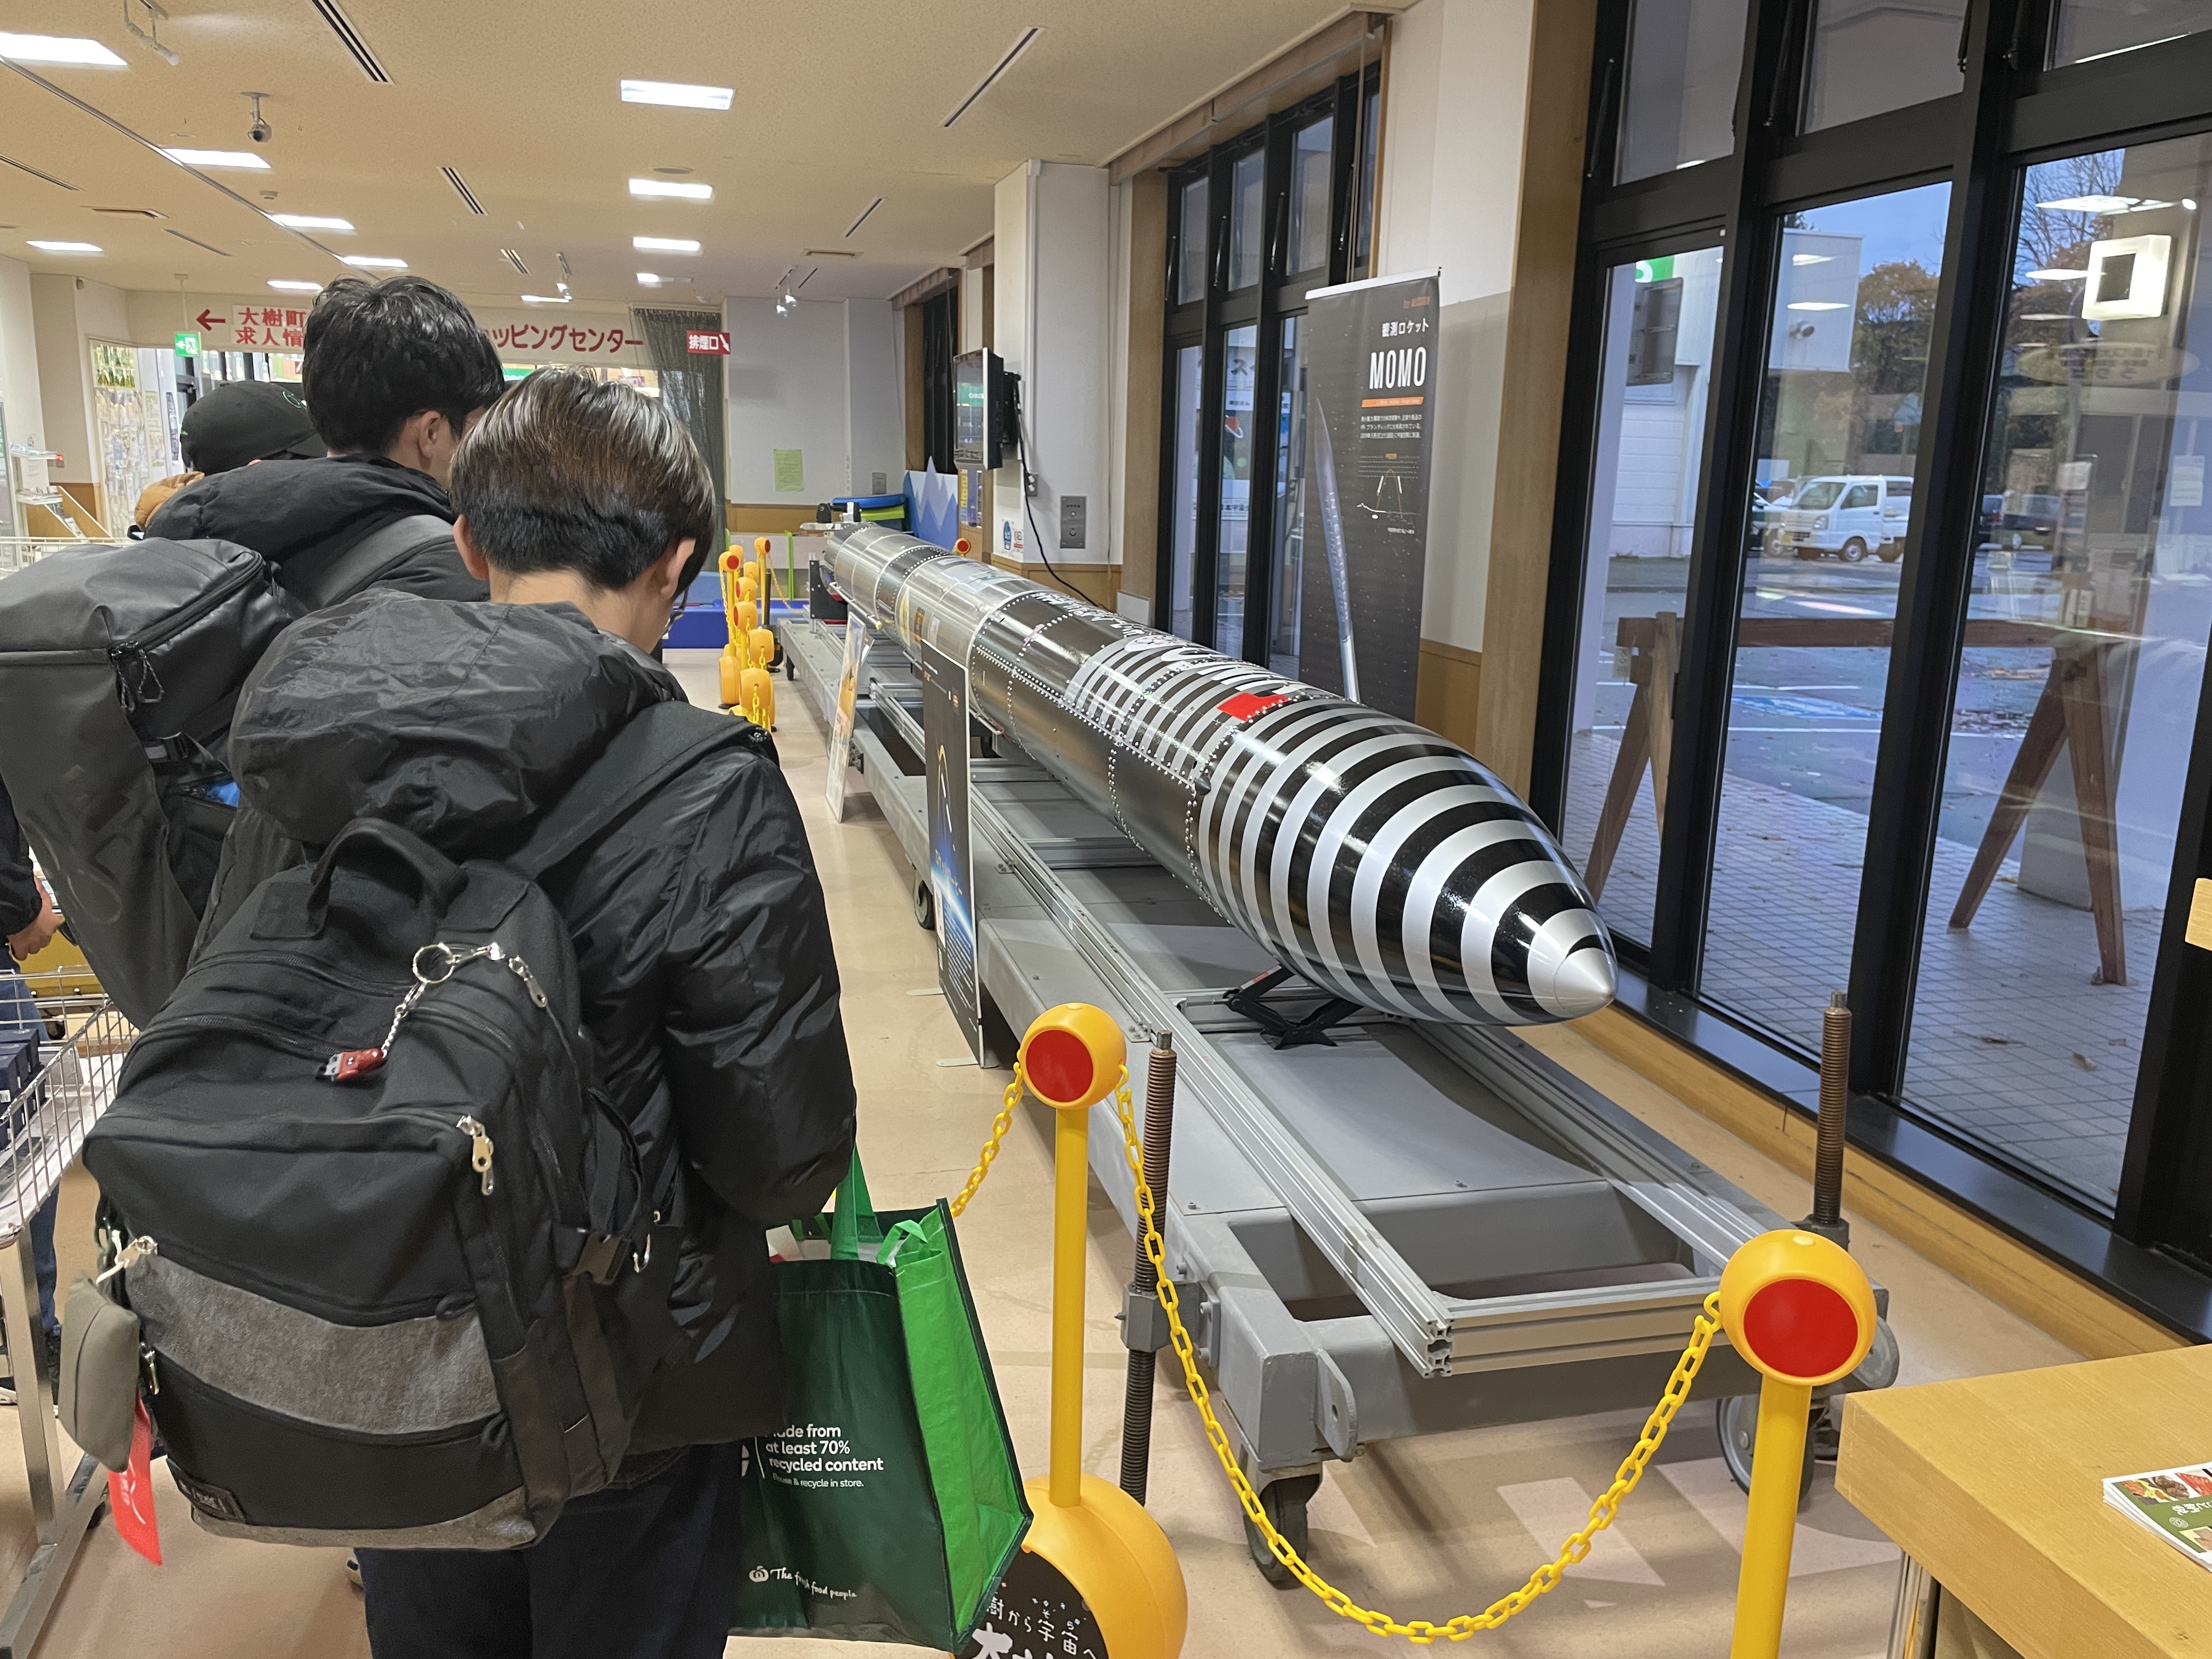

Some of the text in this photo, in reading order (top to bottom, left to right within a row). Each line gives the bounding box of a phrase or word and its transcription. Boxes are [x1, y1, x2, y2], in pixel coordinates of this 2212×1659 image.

[238, 307, 306, 328] 大樹町
[484, 324, 643, 353] ッピングセンター
[689, 335, 718, 351] 排煙口
[1369, 347, 1426, 389] MOMO
[765, 1424, 841, 1438] ade from
[765, 1440, 850, 1454] at least 70%
[769, 1457, 884, 1473] recycled content
[800, 1479, 828, 1489] recycle
[830, 1479, 838, 1487] in
[840, 1479, 864, 1487] store.
[770, 1567, 793, 1579] The
[811, 1581, 828, 1595] food
[830, 1590, 857, 1600] people
